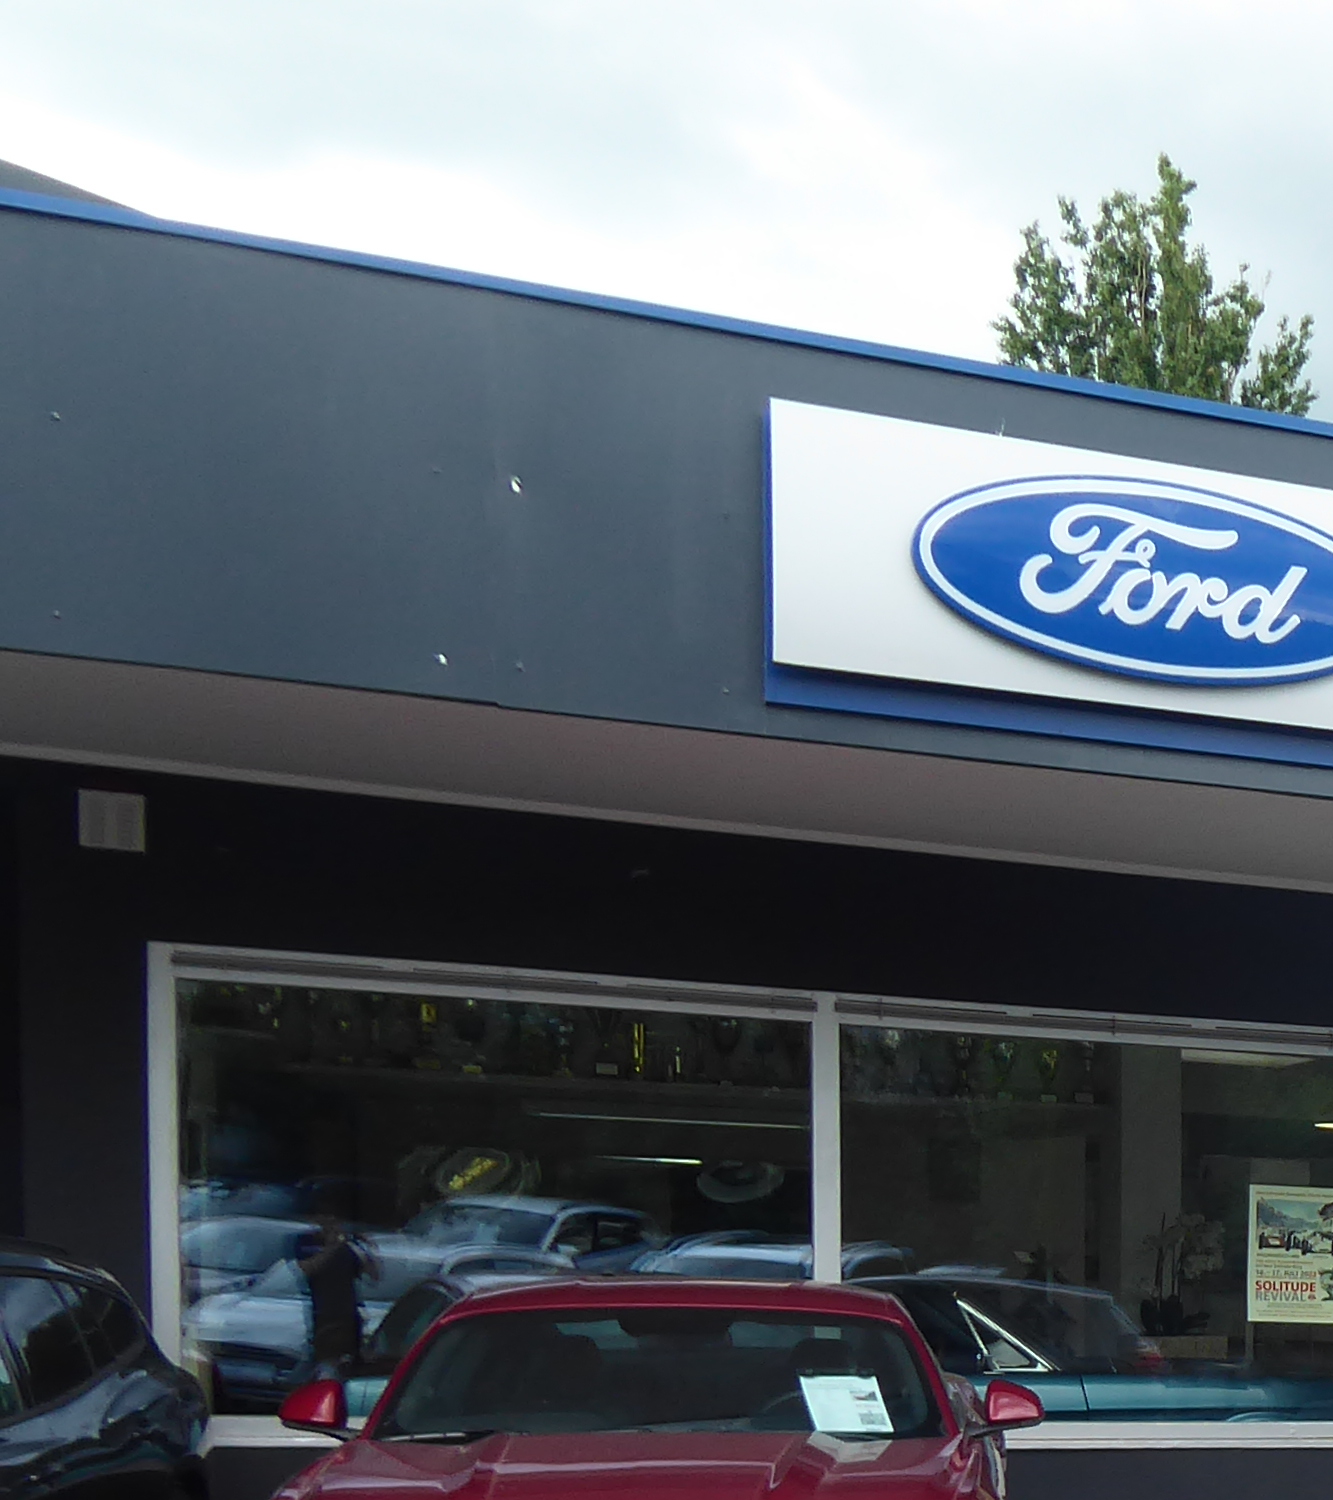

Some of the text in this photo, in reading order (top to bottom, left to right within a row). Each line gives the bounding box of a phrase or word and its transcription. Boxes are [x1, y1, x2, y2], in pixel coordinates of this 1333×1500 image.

[1019, 503, 1308, 645] Ford
[1255, 1280, 1316, 1293] SOLITUDE
[1256, 1291, 1307, 1302] REVIVAL
